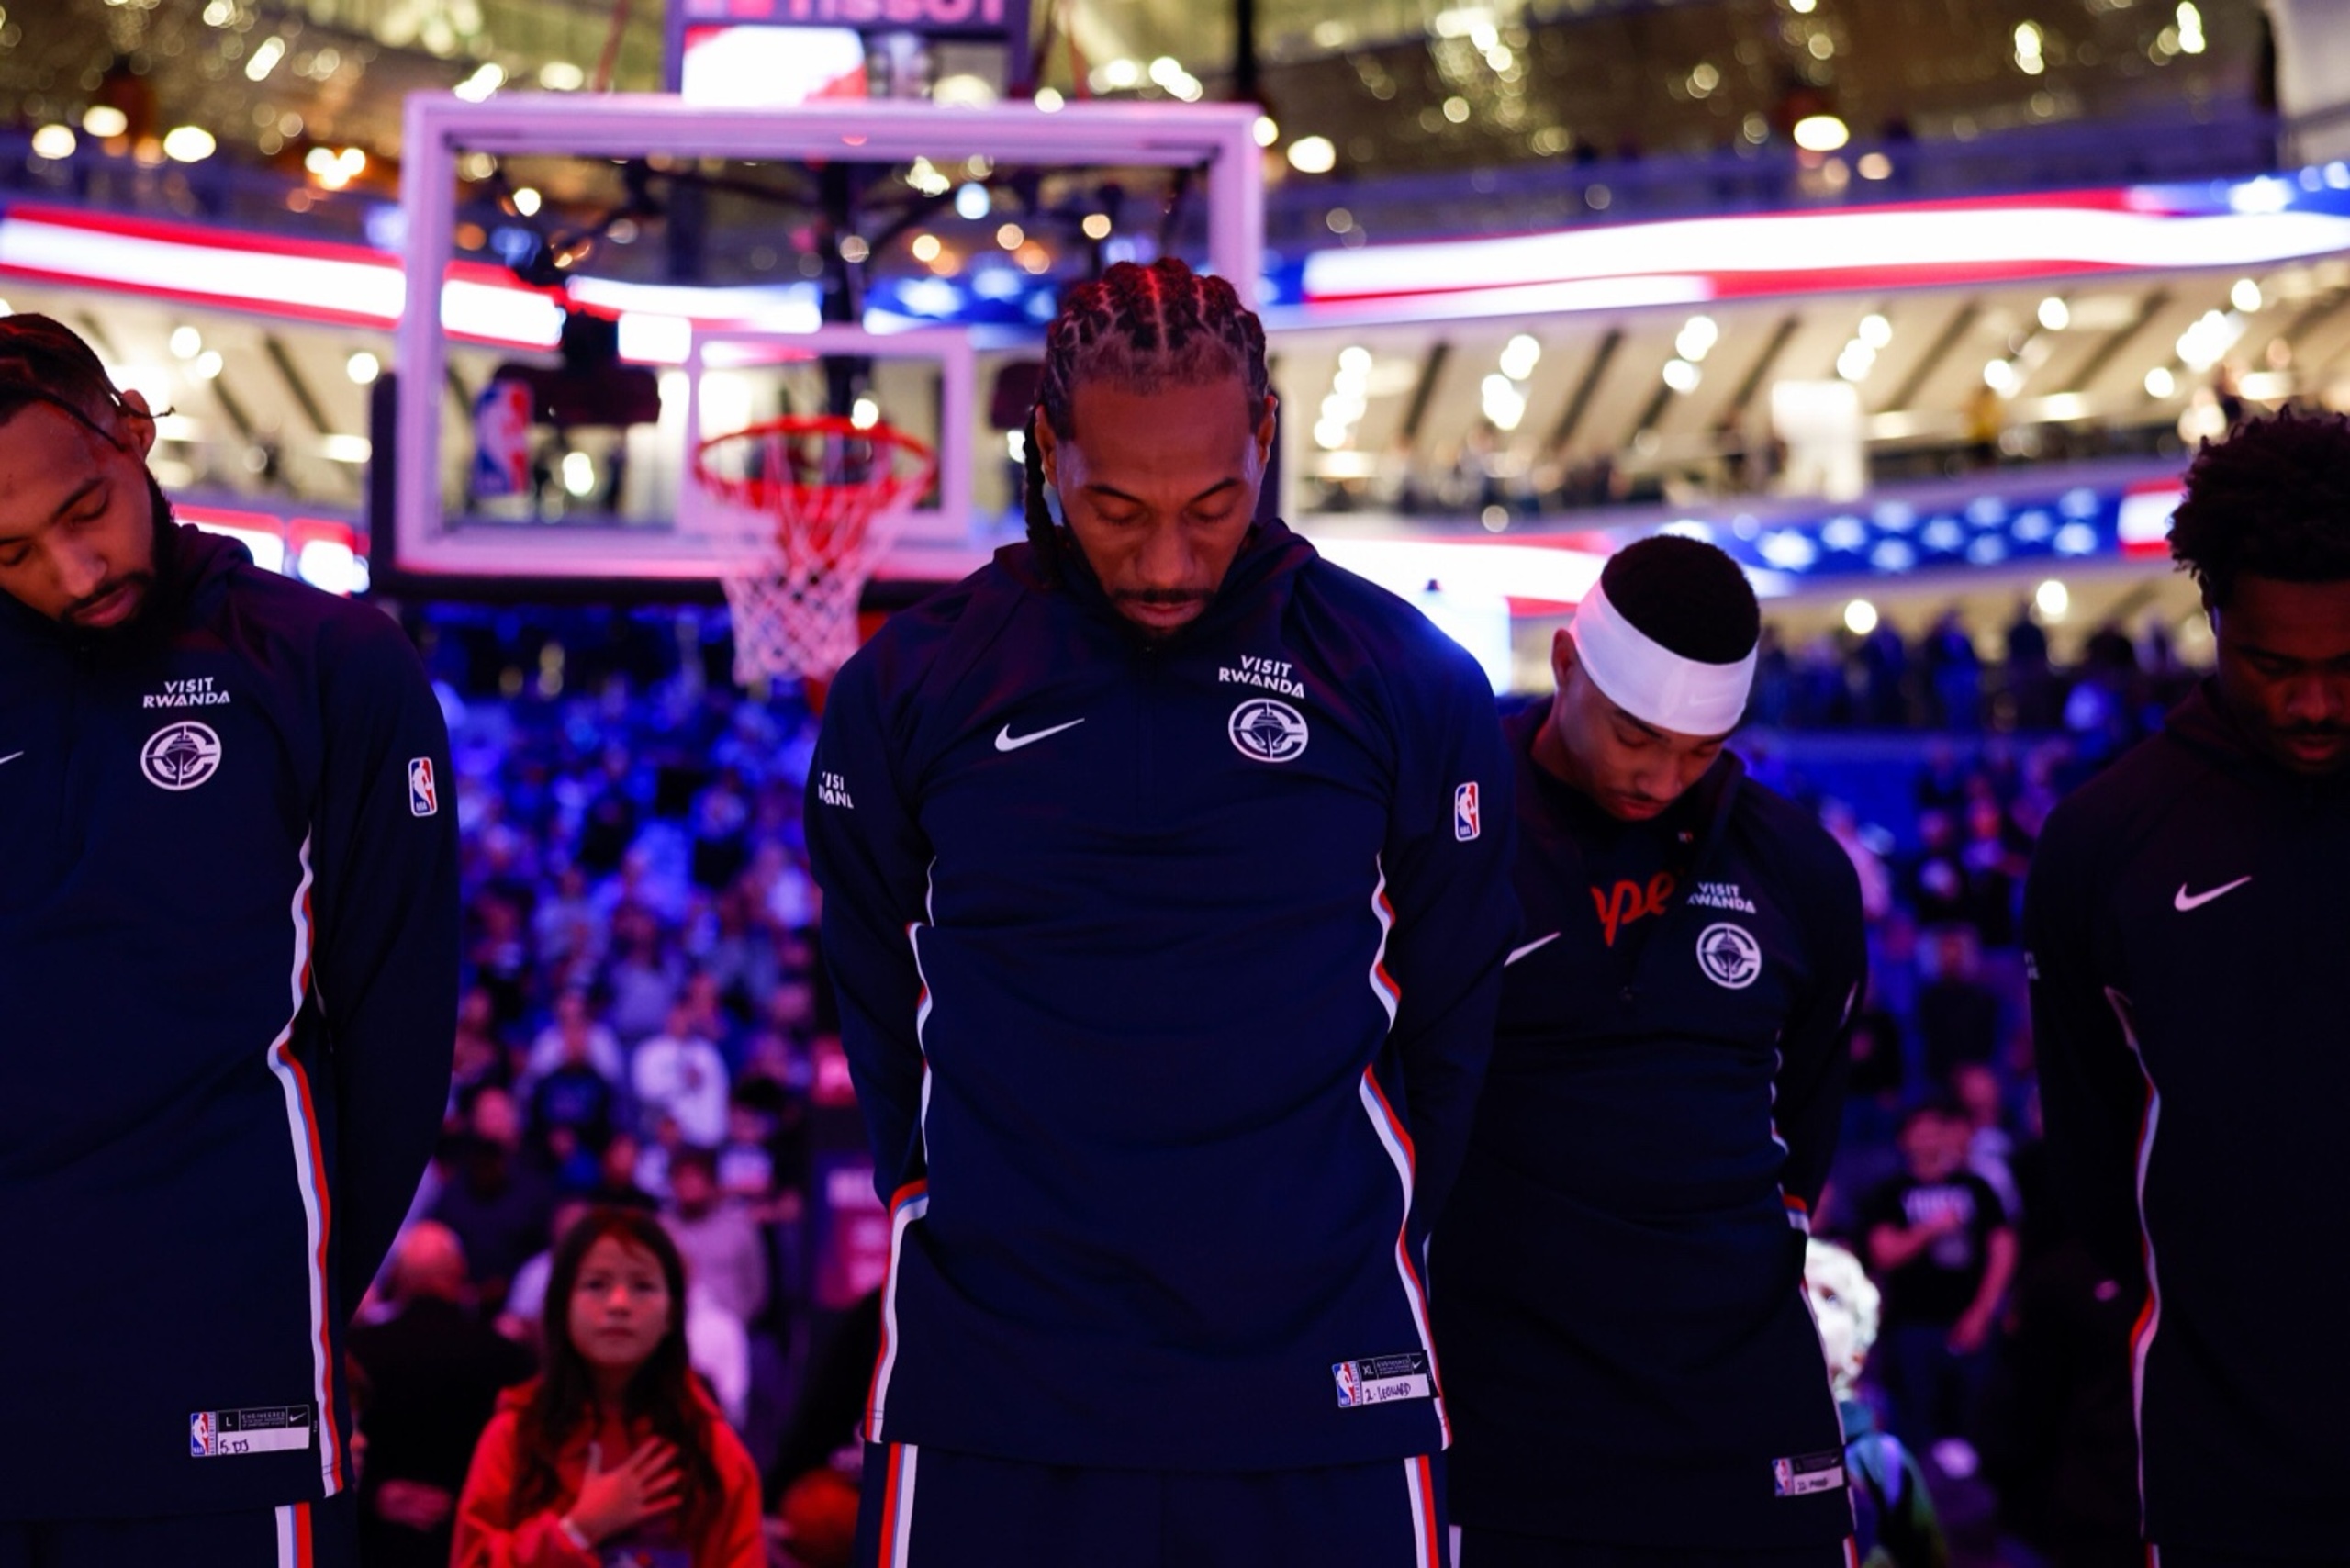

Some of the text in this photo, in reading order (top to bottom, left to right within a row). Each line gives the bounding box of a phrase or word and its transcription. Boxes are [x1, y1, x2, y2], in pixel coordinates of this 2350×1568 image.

[1240, 655, 1292, 678] VISIT
[164, 677, 214, 694] VISIT
[1218, 667, 1305, 699] RWANDA
[143, 690, 230, 708] RWANDA
[1697, 881, 1740, 897] VISIT
[1361, 1365, 1374, 1375] XL
